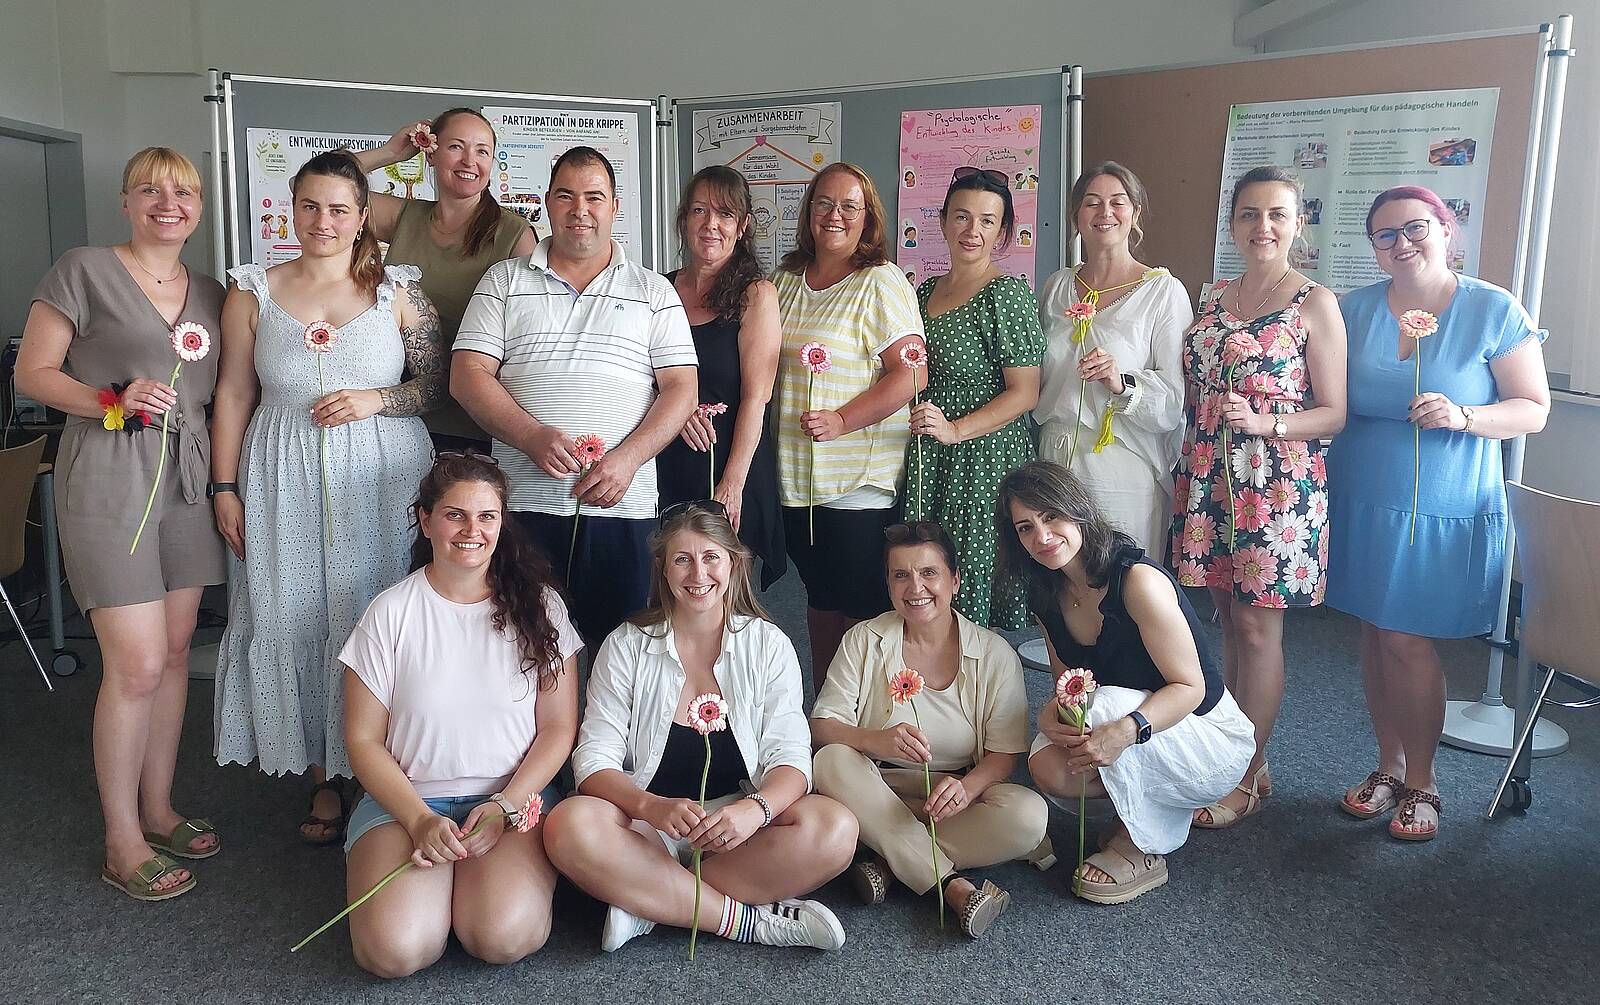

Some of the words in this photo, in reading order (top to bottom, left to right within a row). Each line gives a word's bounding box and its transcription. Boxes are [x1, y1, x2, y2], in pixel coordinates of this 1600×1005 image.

[1282, 108, 1331, 117] vorbereitenden
[1333, 106, 1368, 115] Umgebung
[1369, 104, 1380, 112] für
[1394, 101, 1444, 111] pädagogische
[1446, 100, 1479, 108] Handeln
[502, 115, 565, 127] PARTIZIPATION
[567, 117, 576, 127] IN
[579, 118, 595, 128] DER
[596, 118, 624, 129] KRIPPE
[717, 111, 804, 128] ZUSAMMENARBEIT
[729, 128, 746, 136] Eltern
[761, 123, 807, 134] Sorgeberechtigten
[916, 126, 959, 139] Entwicklung
[962, 124, 975, 134] des
[983, 122, 1011, 134] Kindes
